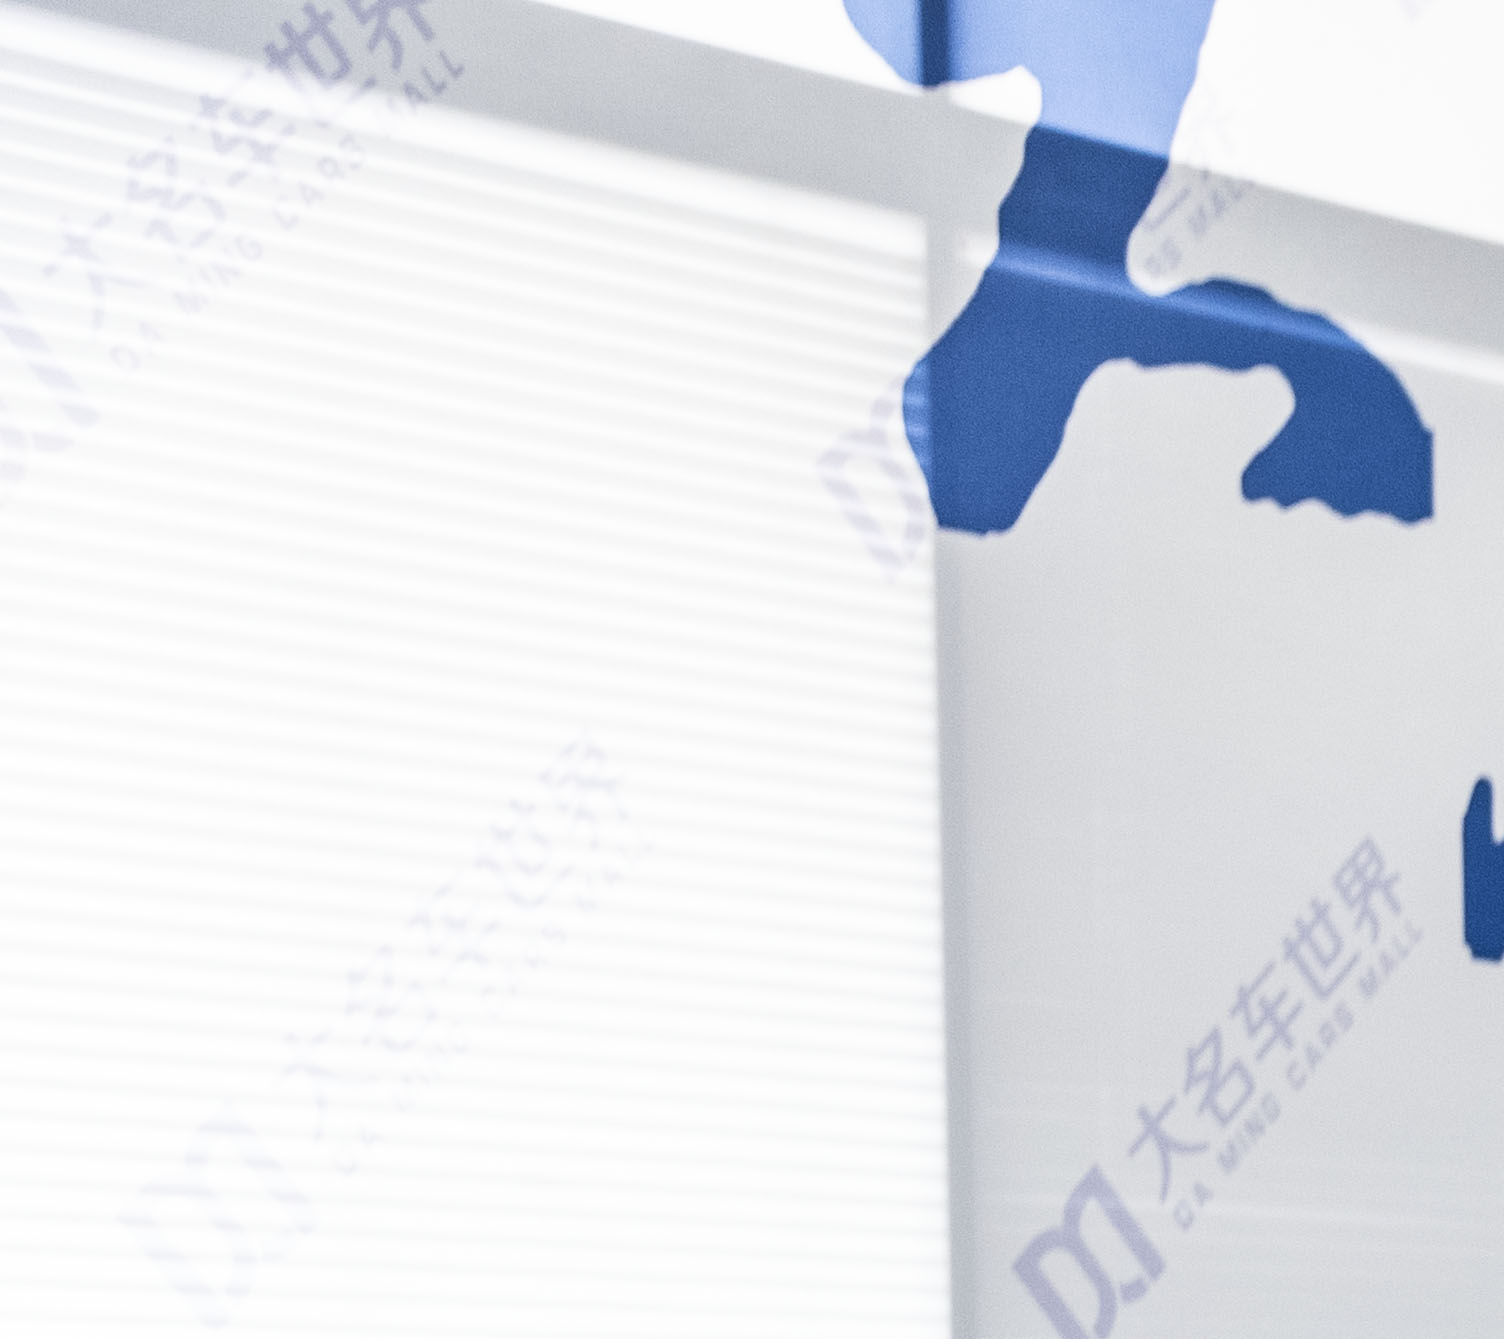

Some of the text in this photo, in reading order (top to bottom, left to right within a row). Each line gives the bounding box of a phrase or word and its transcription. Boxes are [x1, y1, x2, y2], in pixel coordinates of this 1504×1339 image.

[1128, 834, 1401, 1204] 大名车世界
